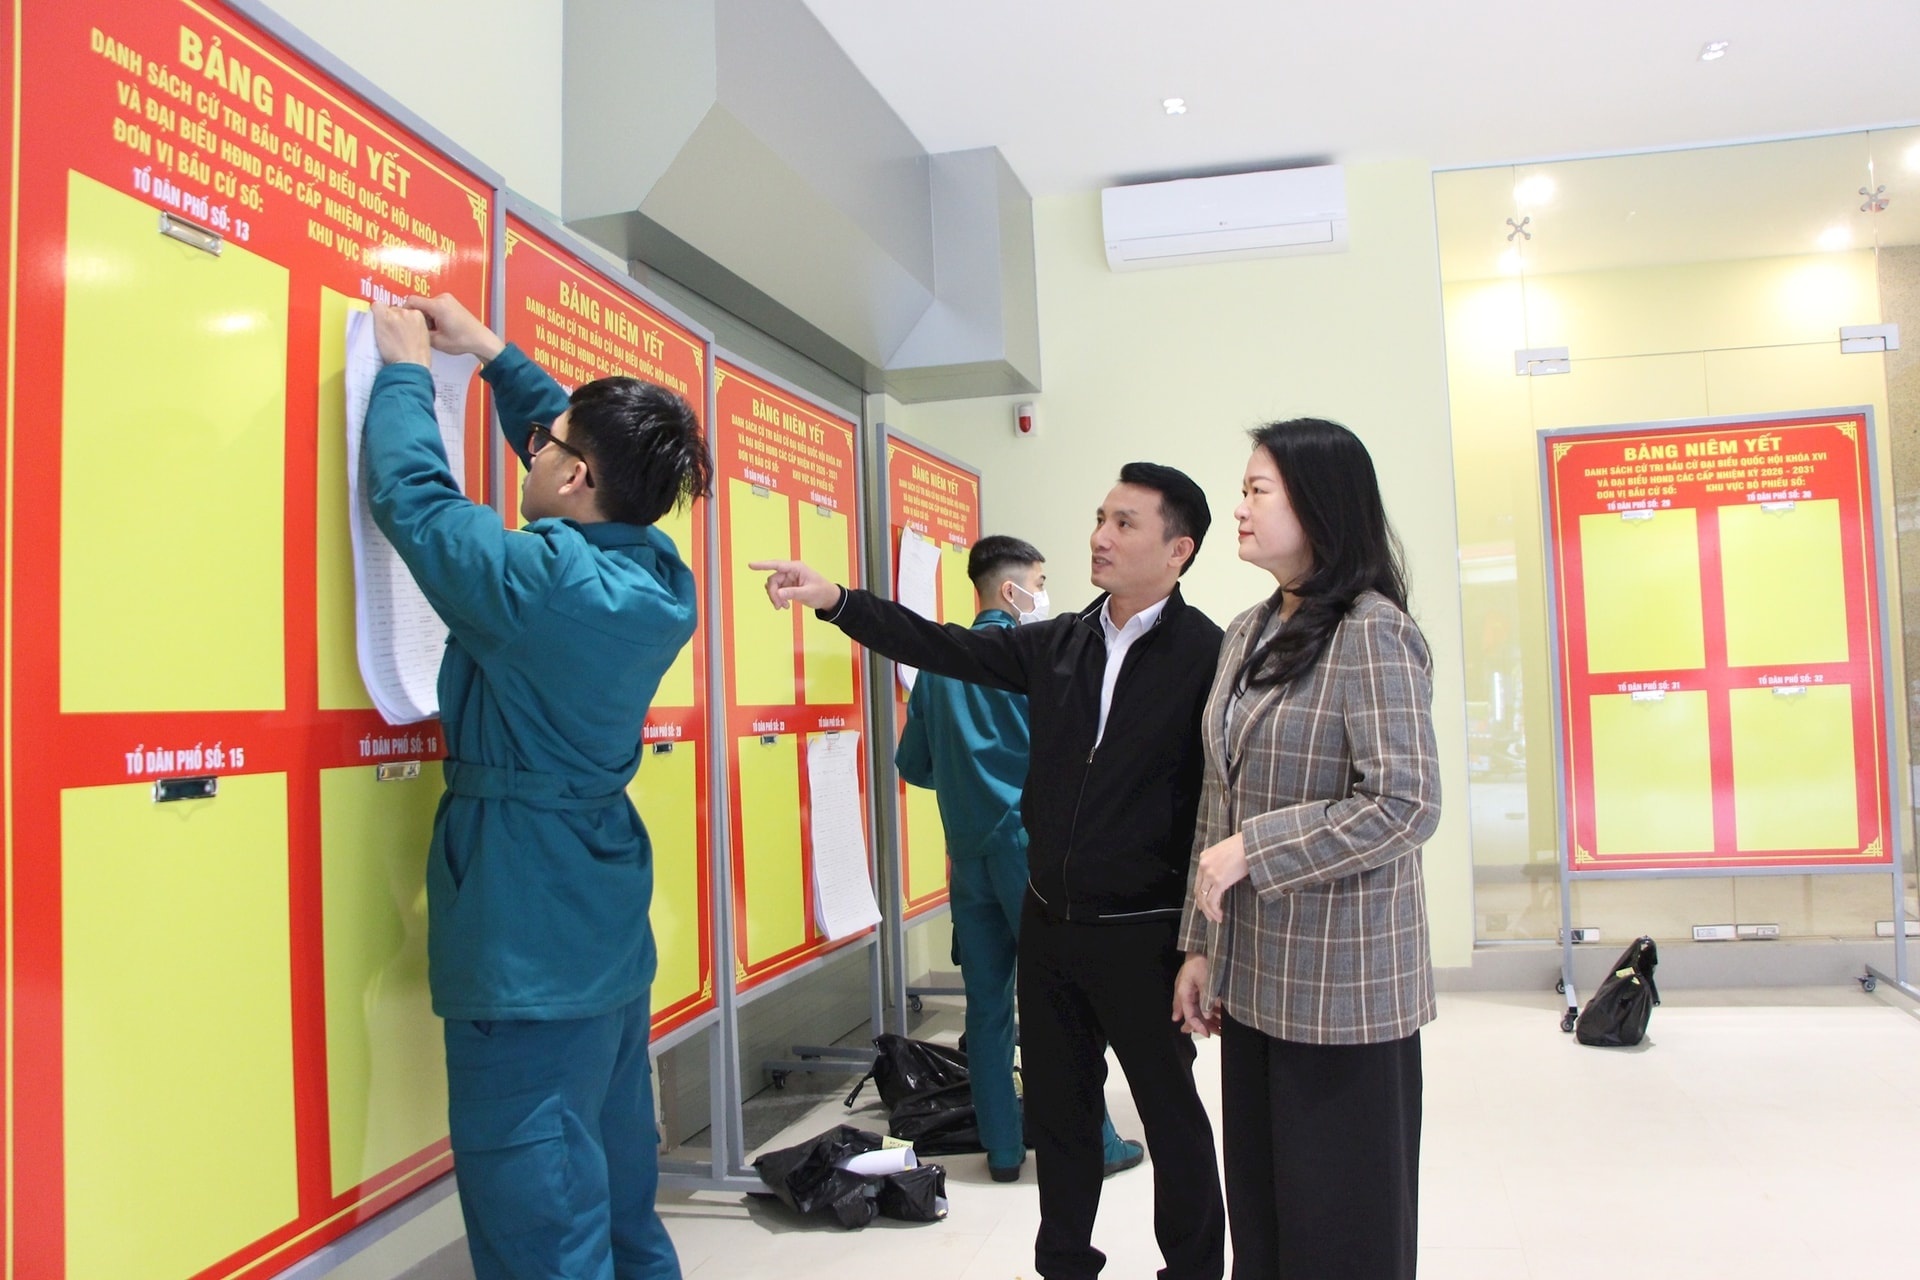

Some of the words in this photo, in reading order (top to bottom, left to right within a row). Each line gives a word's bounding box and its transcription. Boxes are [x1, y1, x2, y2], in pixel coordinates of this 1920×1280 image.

[92, 27, 142, 76] DANH
[148, 61, 192, 105] SÁCH
[197, 91, 220, 120] CỬ
[223, 105, 247, 137] TRI
[251, 122, 279, 155] BẦU
[283, 142, 302, 167] CỬ
[304, 154, 326, 183] ĐẠI
[329, 169, 355, 199] BIỂU
[359, 187, 388, 218] QUỐC
[392, 206, 409, 232] HỘI
[412, 218, 438, 247] KHÓA
[441, 235, 455, 256] XVI
[180, 25, 273, 117] BẢNG
[285, 93, 357, 168] NIÊM
[366, 145, 410, 198] YẾT
[113, 117, 151, 156] ĐƠN
[156, 139, 174, 173] VỊ
[178, 151, 210, 186] BẦU
[215, 171, 237, 199] CỬ
[240, 184, 263, 213] SỐ:
[118, 80, 141, 114] VÀ
[146, 97, 175, 132] ĐẠI
[180, 116, 217, 154] BIỂU
[221, 140, 261, 178] HĐND
[266, 165, 293, 195] CÁC
[297, 182, 321, 209] CẤP
[325, 197, 363, 233] NHIỆM
[366, 220, 380, 242] KỲ
[133, 166, 152, 193] TỔ
[153, 177, 181, 208] DÂN
[183, 192, 209, 221] PHỐ
[211, 205, 230, 231] SỐ:
[235, 219, 249, 241] 13
[308, 219, 333, 248] KHU
[337, 234, 360, 261] VỰC
[415, 275, 430, 297] SỐ:
[560, 280, 600, 325] BẢNG
[605, 307, 639, 347] NIÊM
[642, 329, 665, 361] YẾT
[586, 371, 598, 385] SỐ
[753, 398, 779, 426] BẢNG
[783, 413, 806, 438] NIÊM
[809, 424, 824, 445] YẾT
[1624, 443, 1678, 461] BẢNG
[1685, 439, 1738, 457] NIÊM
[1745, 433, 1782, 452] YẾT
[1761, 467, 1784, 476] 2026
[1793, 465, 1814, 474] 2031
[1812, 452, 1827, 461] XVI
[125, 744, 144, 774] TỔ
[146, 747, 174, 773] DÂN
[177, 742, 203, 771] PHỐ
[205, 741, 225, 769] SỐ:
[229, 748, 244, 768] 15
[359, 733, 371, 757] TỔ
[373, 736, 390, 756] DÂN
[392, 732, 409, 754] PHỐ
[411, 731, 424, 753] SỐ:
[427, 737, 437, 753] 16
